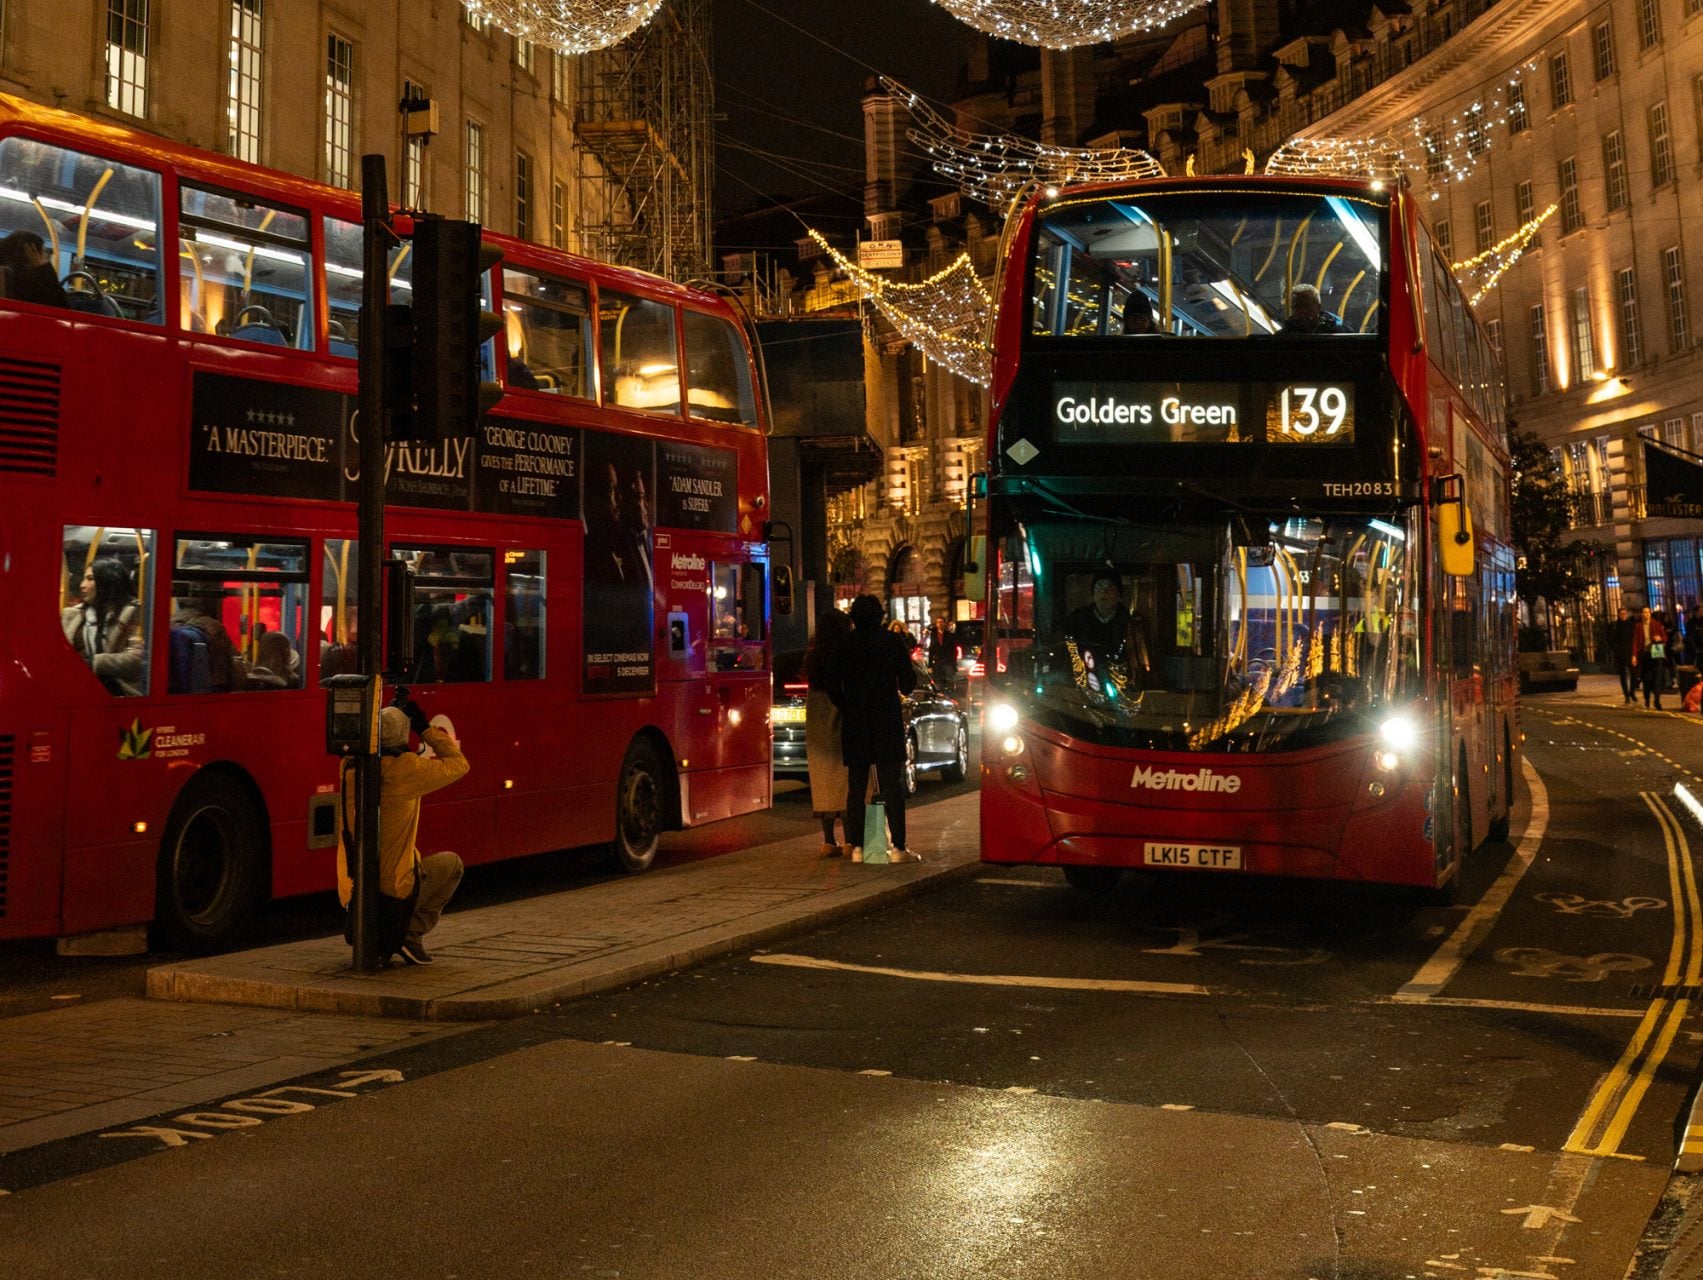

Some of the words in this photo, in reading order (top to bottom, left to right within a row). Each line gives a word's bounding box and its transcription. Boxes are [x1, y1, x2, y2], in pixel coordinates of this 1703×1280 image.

[1056, 397, 1153, 424] Golders
[1160, 397, 1237, 424] Green
[1281, 387, 1347, 435] 139
[528, 432, 573, 455] CLOONEY
[481, 454, 500, 469] GIVES
[501, 457, 514, 470] THE
[514, 454, 575, 477] PERFORMANCE
[500, 480, 510, 493] OF
[510, 481, 517, 493] A
[692, 478, 723, 497] SANDLER
[1322, 482, 1393, 497] TEH2083
[671, 552, 705, 571] Metroline
[587, 653, 594, 664] IN
[594, 653, 613, 664] SELECT
[613, 652, 637, 663] CINEMAS
[637, 652, 649, 662] NOW
[622, 666, 649, 676] DECEMBER
[1130, 765, 1241, 794] Metroline
[1151, 847, 1190, 865] LK15
[1198, 848, 1233, 866] CTF
[98, 1086, 358, 1146] LOOK
